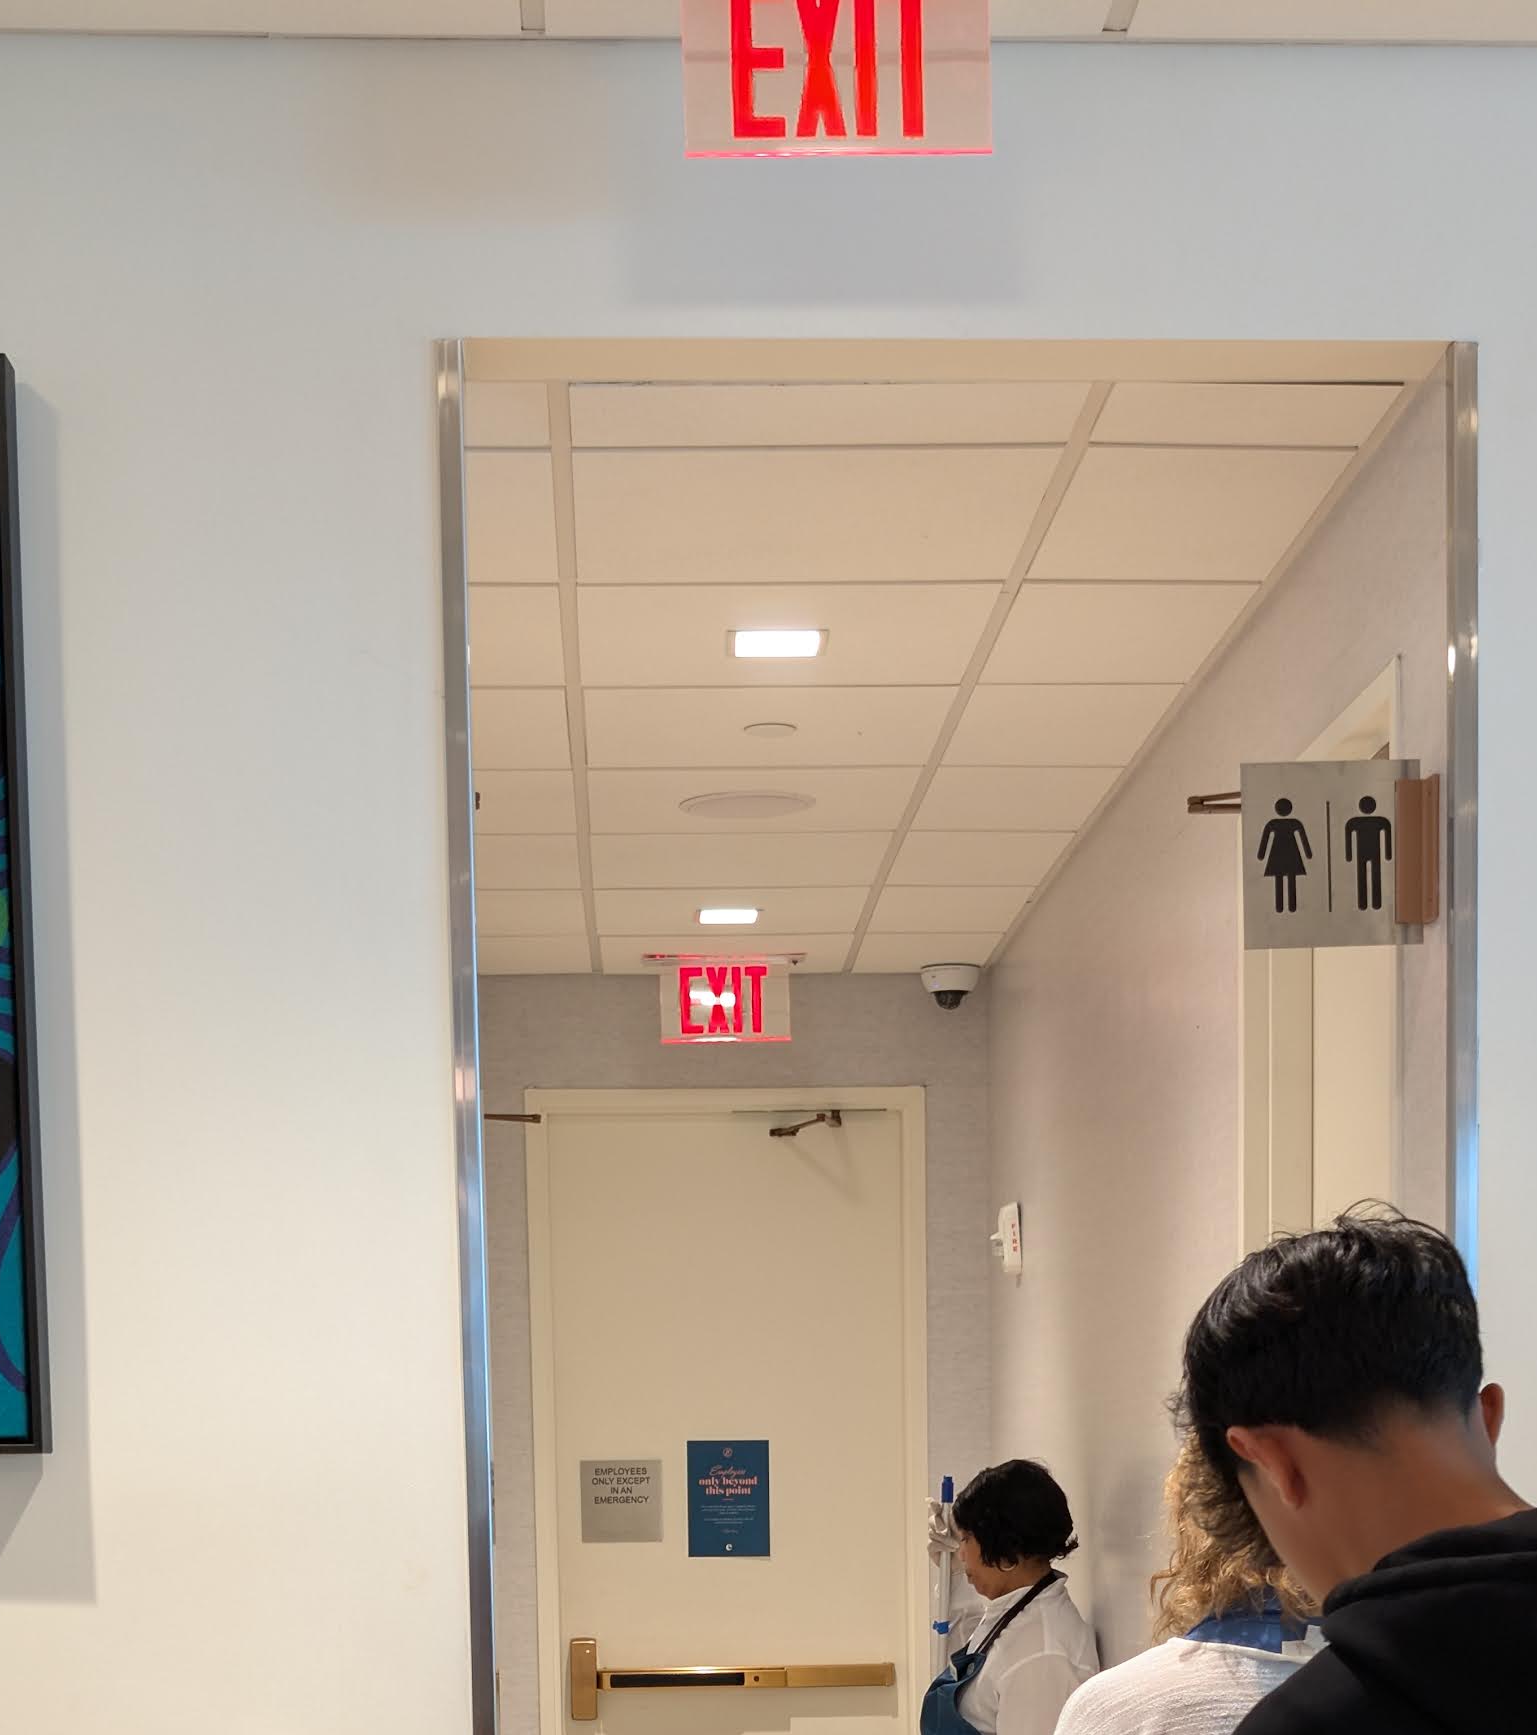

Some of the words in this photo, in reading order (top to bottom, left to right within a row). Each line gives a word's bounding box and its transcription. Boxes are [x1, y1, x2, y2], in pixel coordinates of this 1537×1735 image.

[731, 0, 924, 138] EXIT
[679, 965, 768, 1034] EXIT
[594, 1467, 647, 1476] EMPLOYEES
[591, 1477, 614, 1485] ONLY
[616, 1476, 650, 1485] EXCEPT
[698, 1476, 719, 1488] only
[722, 1476, 758, 1487] beyond
[705, 1486, 724, 1495] this
[725, 1486, 751, 1496] point
[594, 1496, 649, 1504] EMERGENCY
